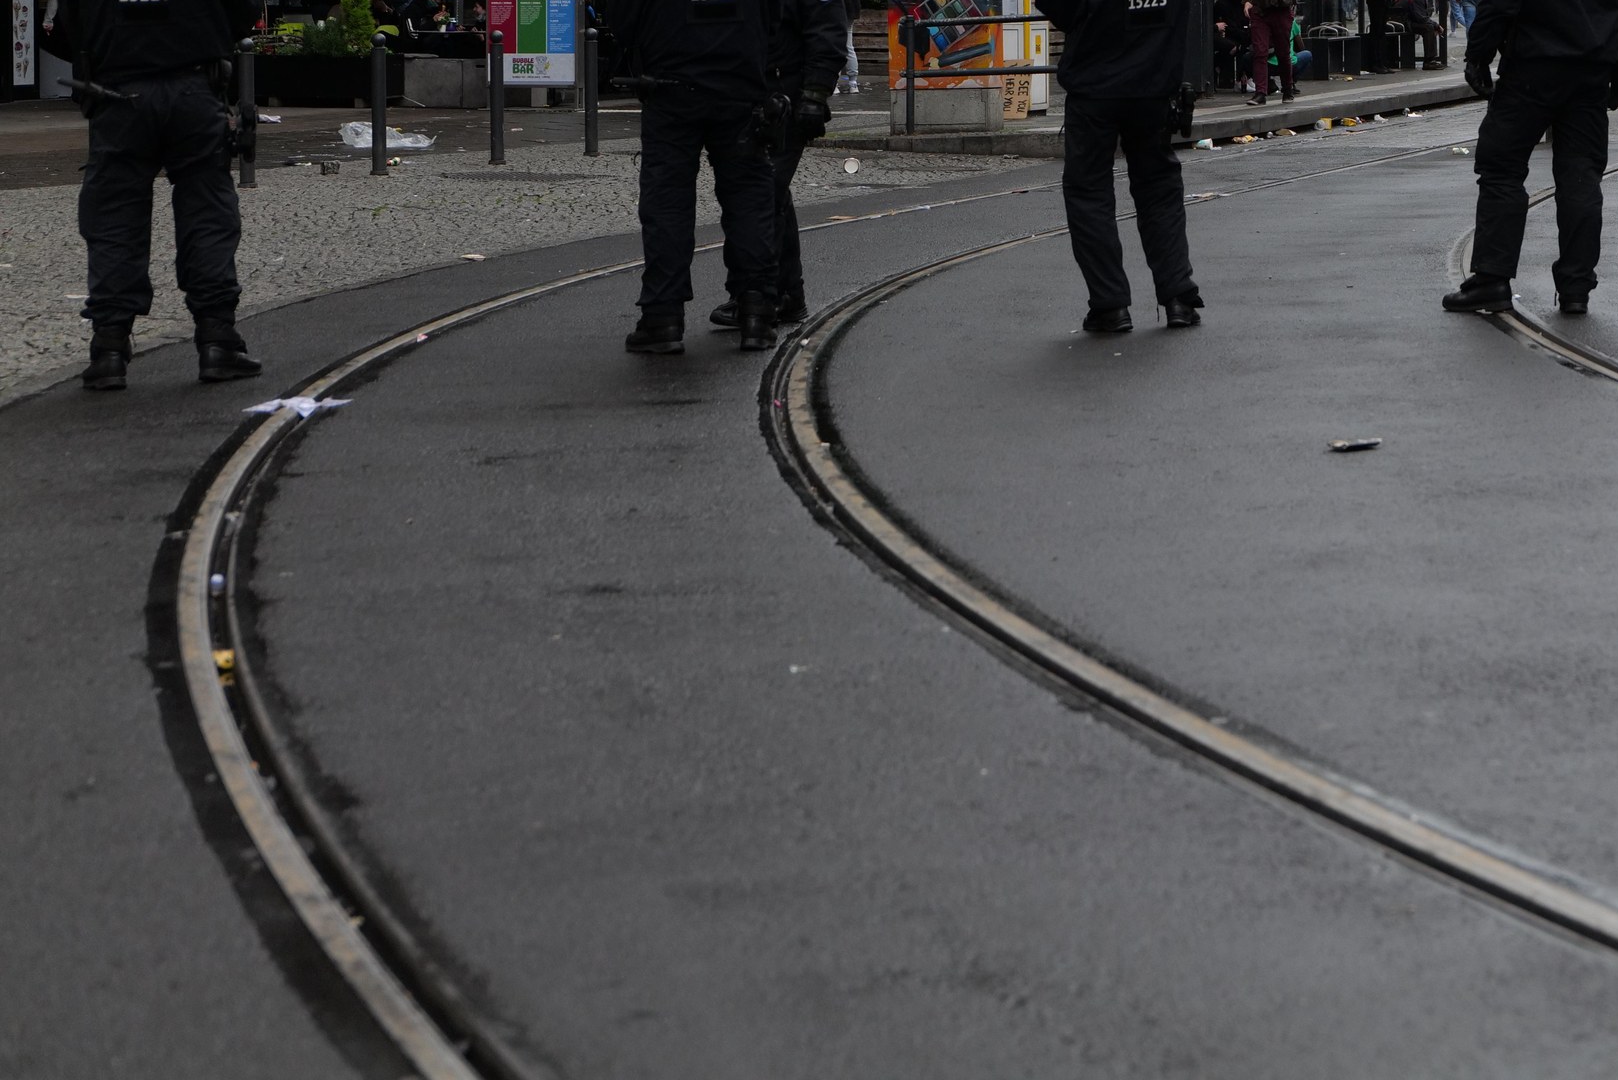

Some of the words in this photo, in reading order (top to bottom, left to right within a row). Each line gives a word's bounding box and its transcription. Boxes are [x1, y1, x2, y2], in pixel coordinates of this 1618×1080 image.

[512, 63, 535, 74] BÄR
[1004, 78, 1015, 96] HEAR
[1017, 80, 1030, 96] SEE
[1002, 96, 1014, 112] YOU
